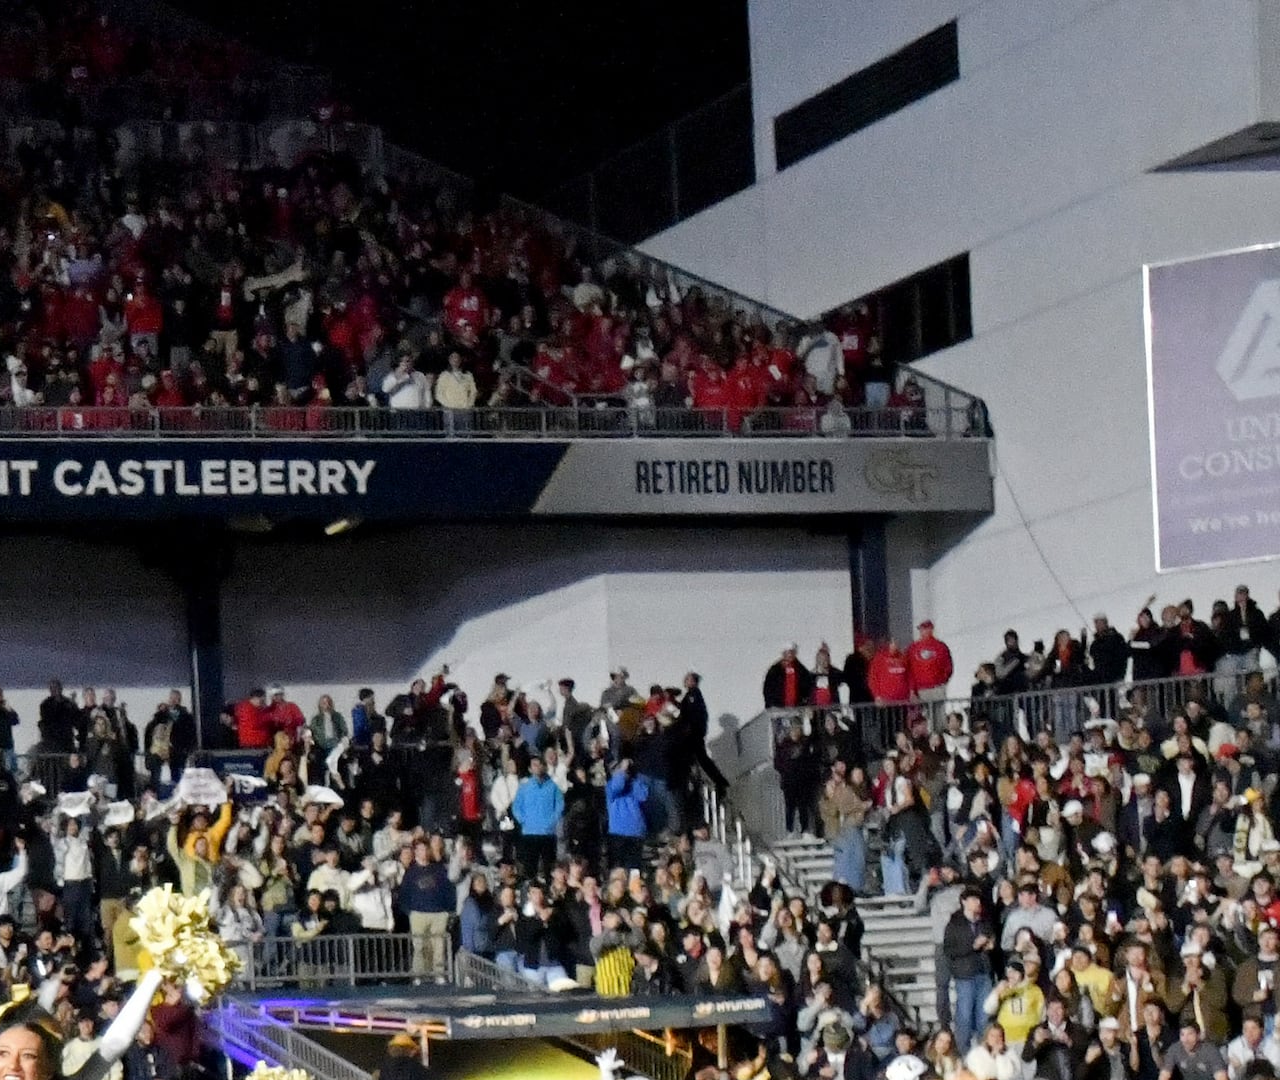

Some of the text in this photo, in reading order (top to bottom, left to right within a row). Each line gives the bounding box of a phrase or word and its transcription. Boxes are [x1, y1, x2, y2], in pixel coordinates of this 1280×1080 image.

[53, 460, 376, 496] CASTLEBERRY
[636, 459, 836, 495] RETIRED NUMBER
